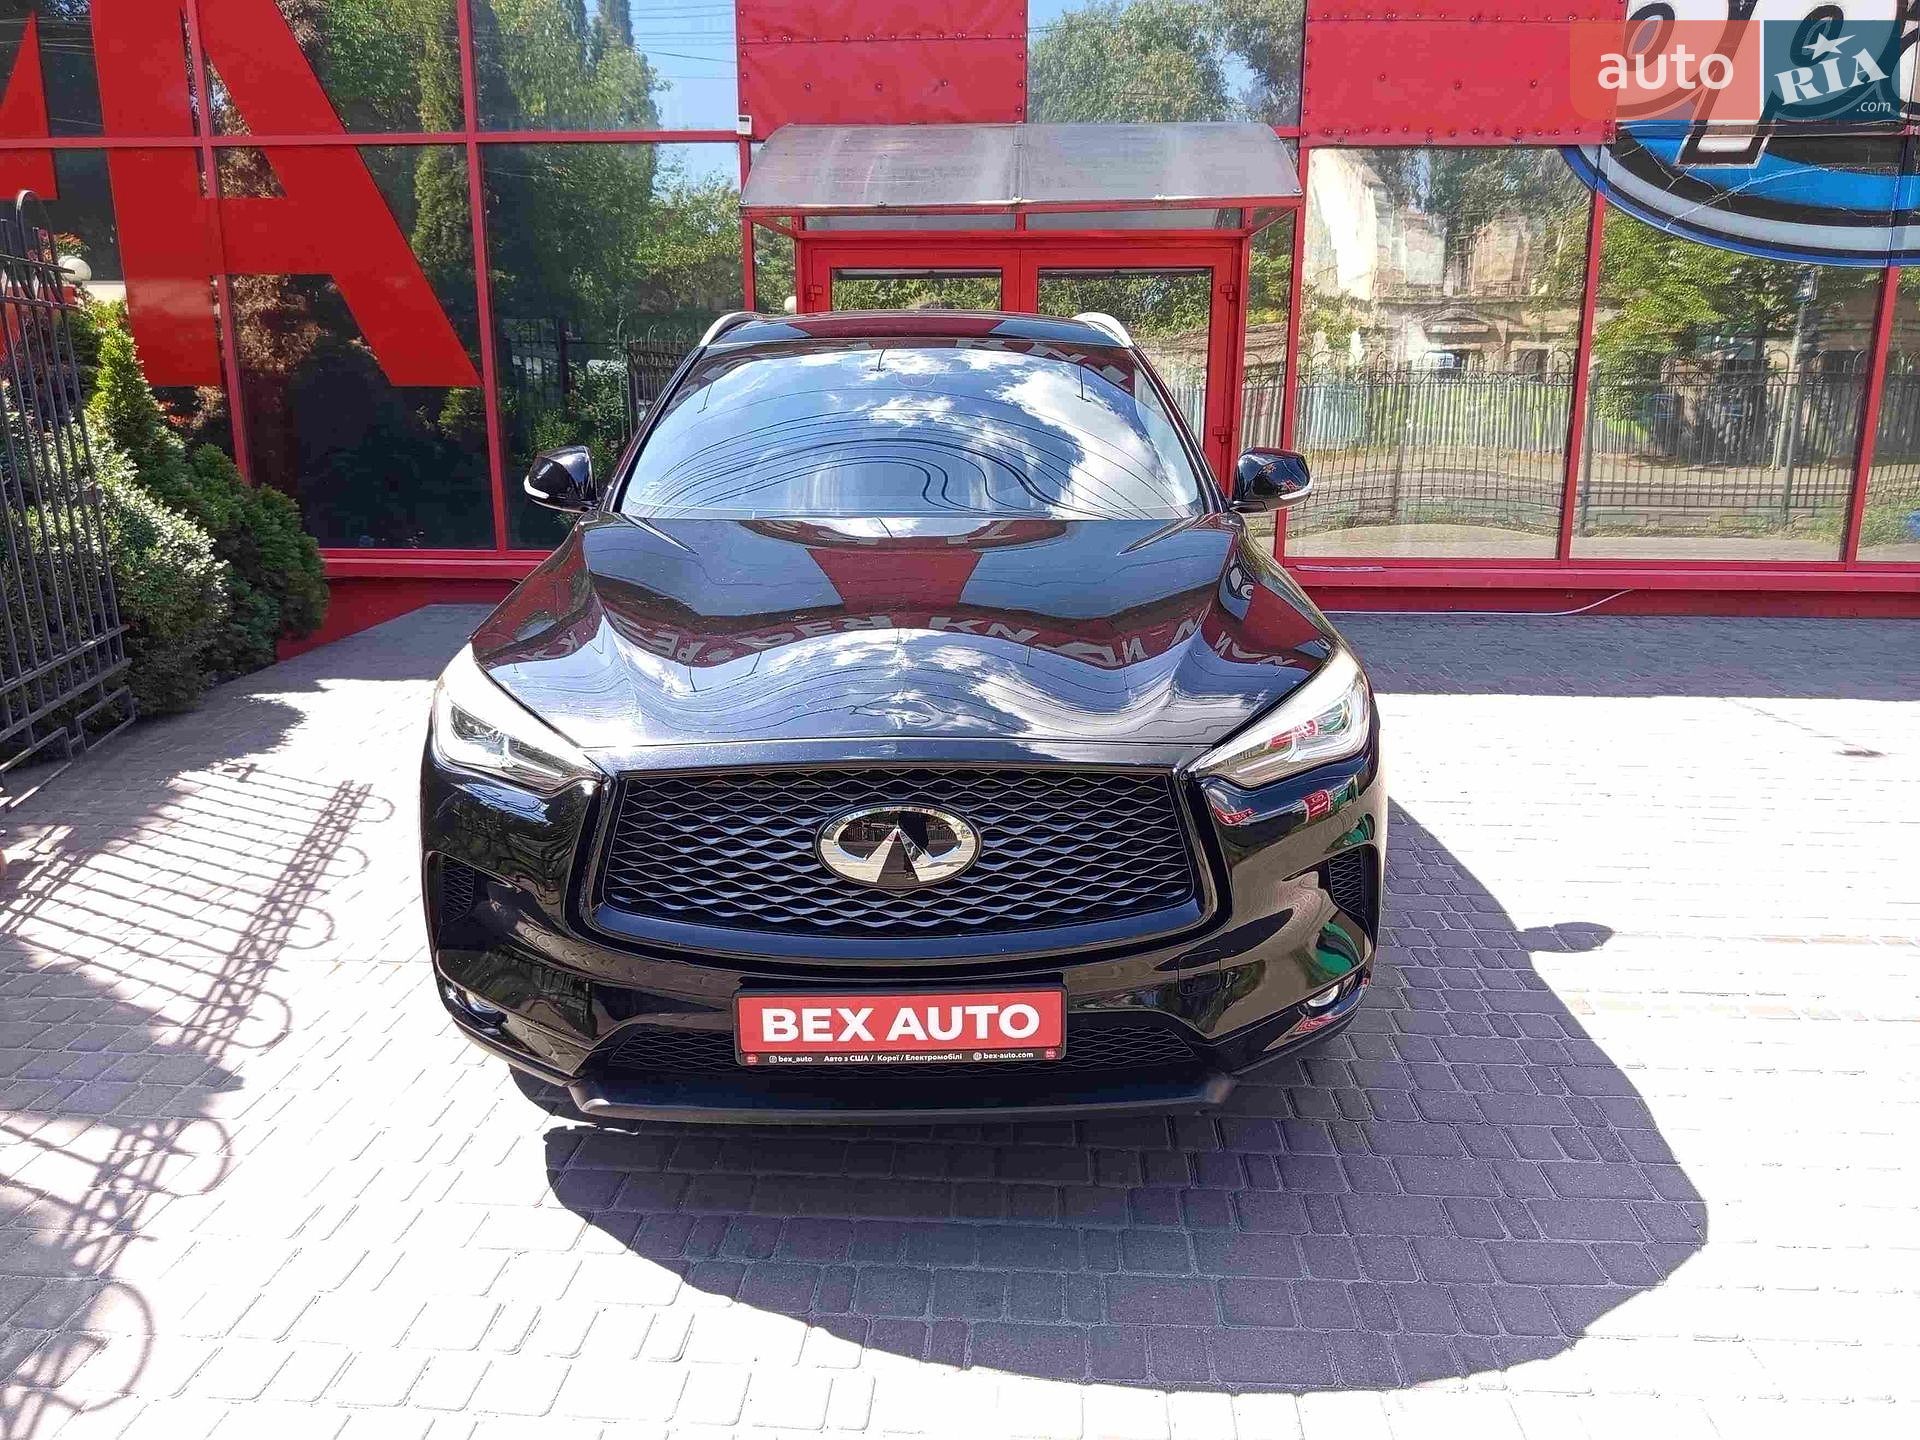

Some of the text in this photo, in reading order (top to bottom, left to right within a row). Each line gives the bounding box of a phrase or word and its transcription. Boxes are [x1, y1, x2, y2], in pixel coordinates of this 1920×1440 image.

[761, 1003, 1040, 1043] BEX AUTO
[778, 1055, 813, 1064] bex_auto
